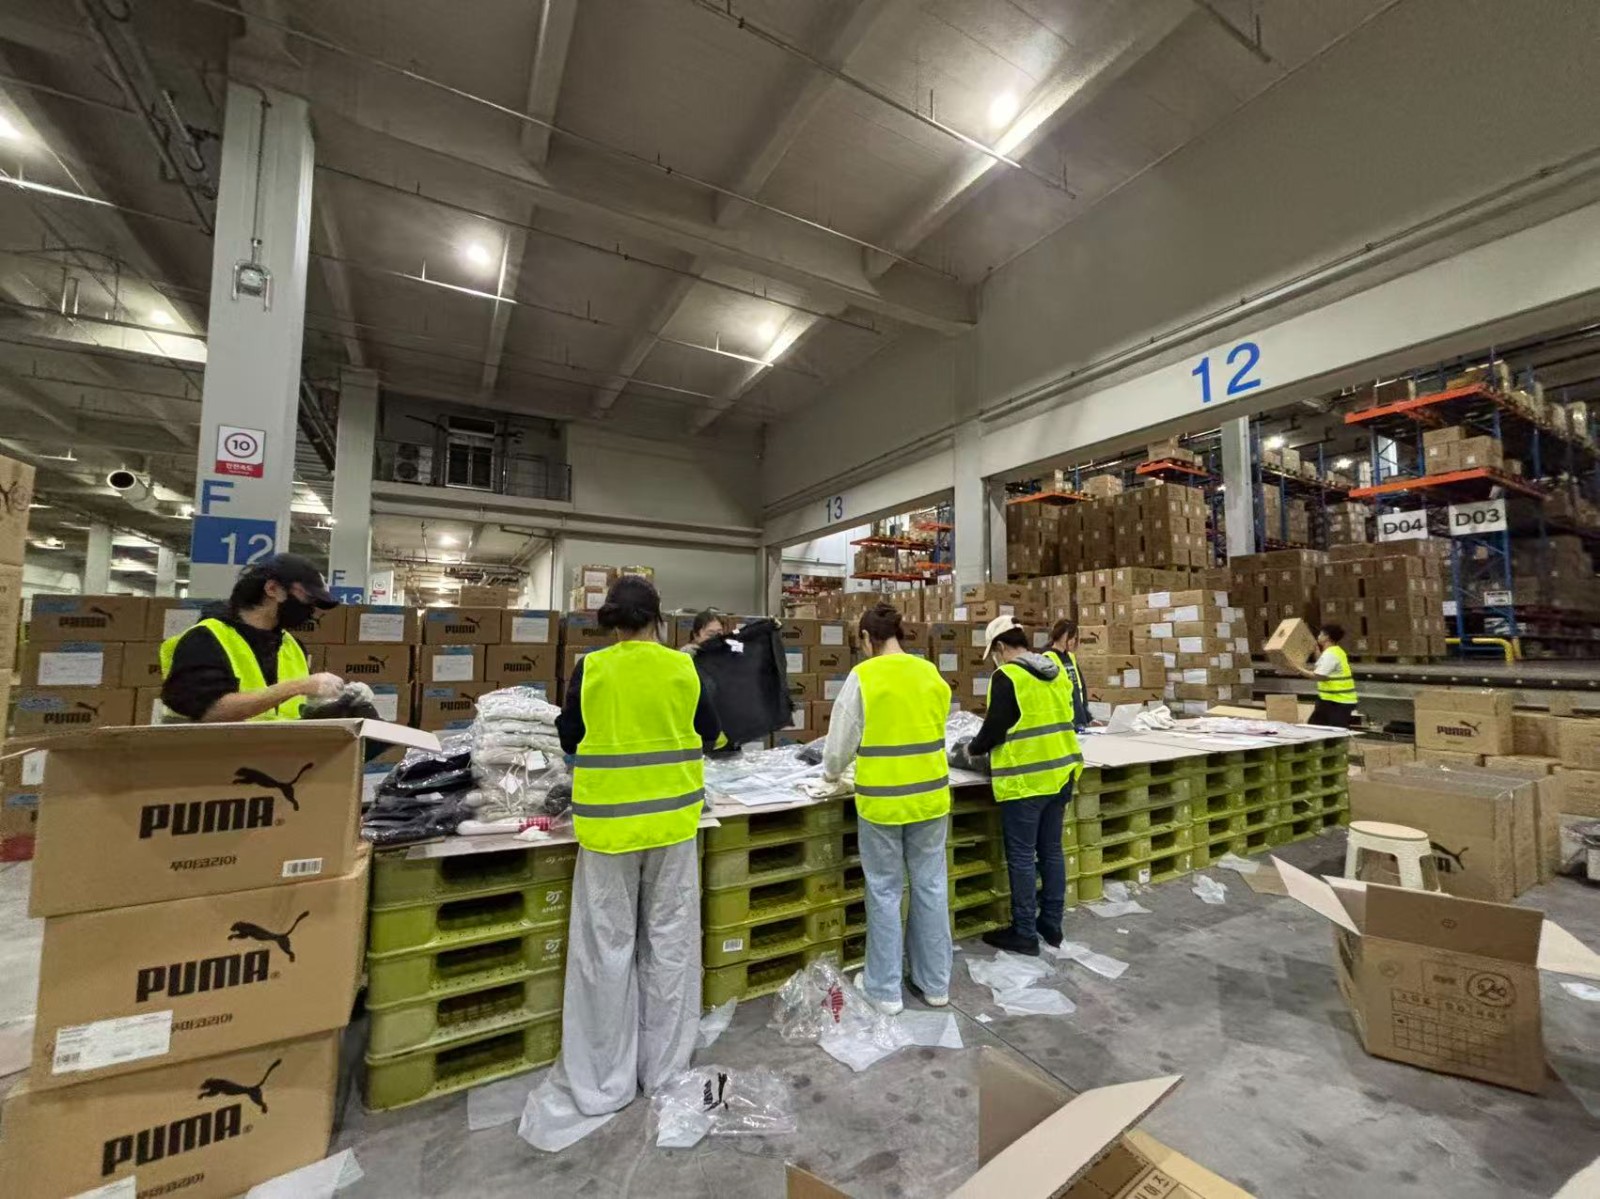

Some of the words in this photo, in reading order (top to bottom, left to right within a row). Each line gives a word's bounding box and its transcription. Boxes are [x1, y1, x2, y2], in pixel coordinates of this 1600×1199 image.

[1192, 342, 1261, 403] 12
[232, 439, 250, 451] 10
[202, 479, 234, 514] F
[826, 496, 843, 523] 13
[1383, 518, 1423, 535] D04
[1455, 508, 1500, 526] D03
[220, 532, 274, 566] 12
[333, 570, 346, 585] F
[345, 663, 380, 674] PUMA
[1436, 725, 1472, 737] PUMA
[139, 796, 275, 839] PUMA
[136, 949, 270, 1003] PUMA
[102, 1103, 242, 1176] PUMA
